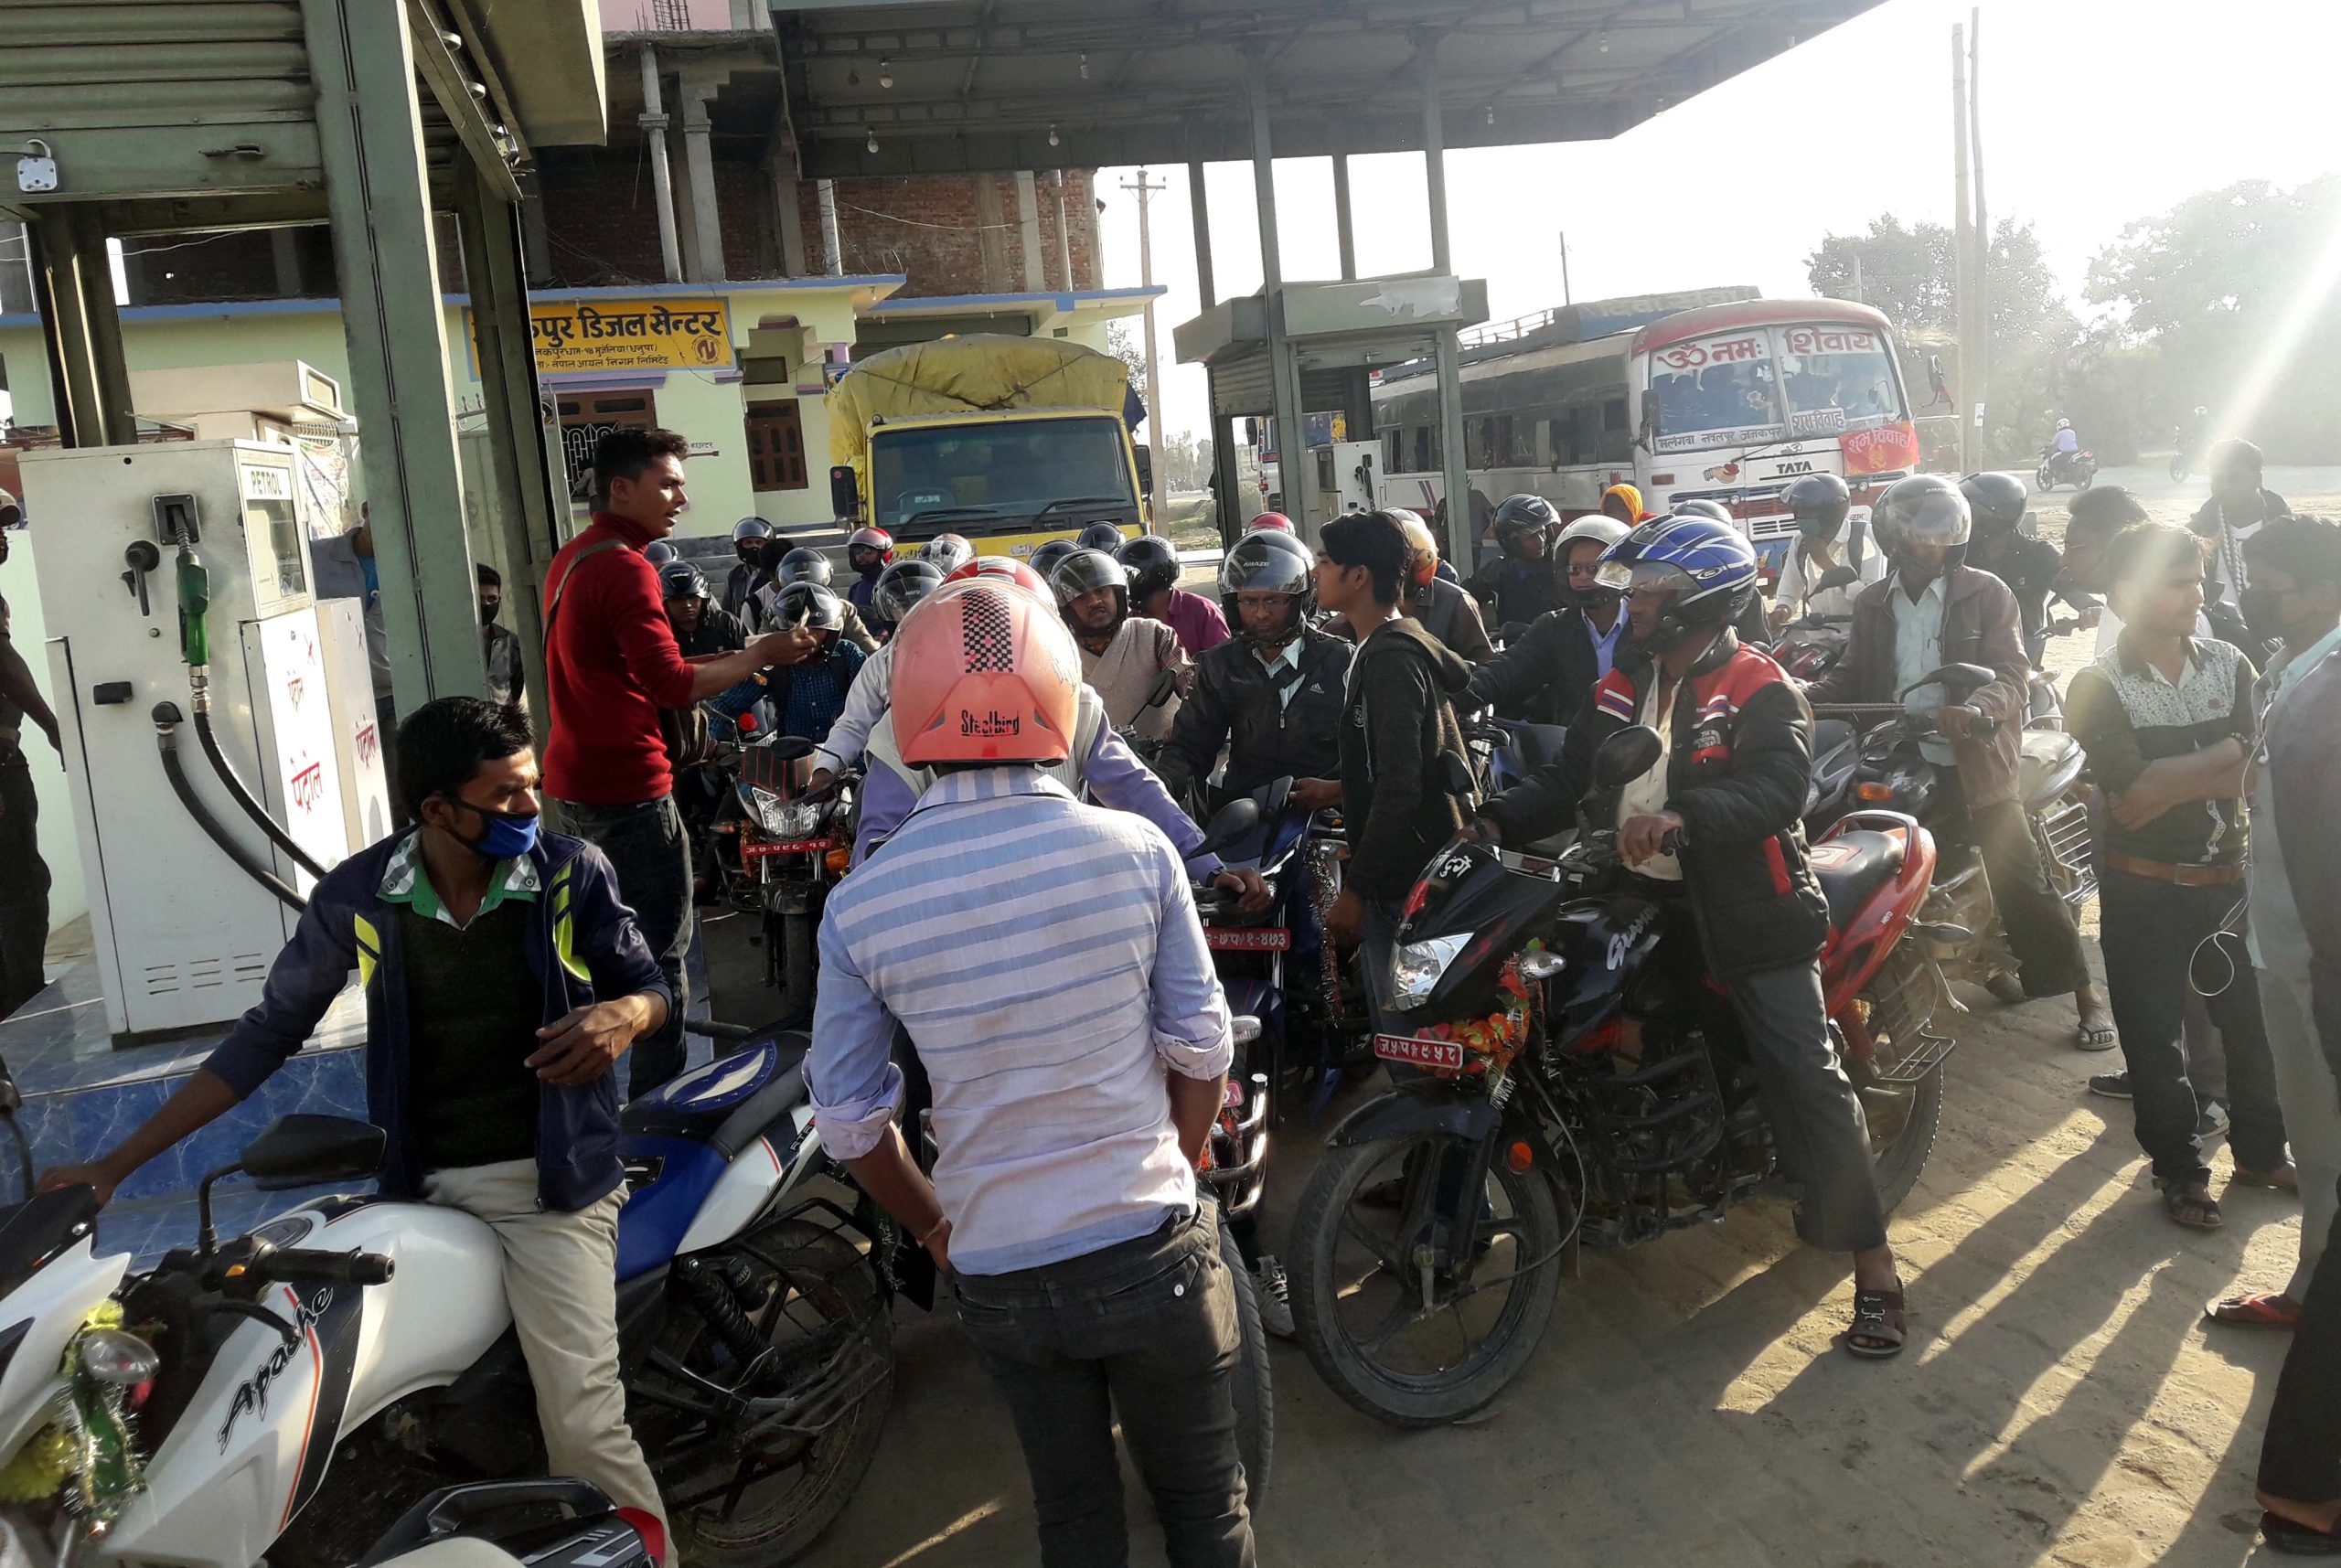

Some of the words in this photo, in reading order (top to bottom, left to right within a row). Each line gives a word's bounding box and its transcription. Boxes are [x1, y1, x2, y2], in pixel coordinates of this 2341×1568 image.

[576, 306, 647, 338] डिजल
[649, 305, 722, 336] सेन्टर
[1783, 327, 1875, 354] शिवाय
[1777, 461, 1812, 474] TATA
[251, 470, 283, 495] PETROL
[290, 750, 323, 815] पेट्रोल
[790, 1125, 814, 1151] RTR
